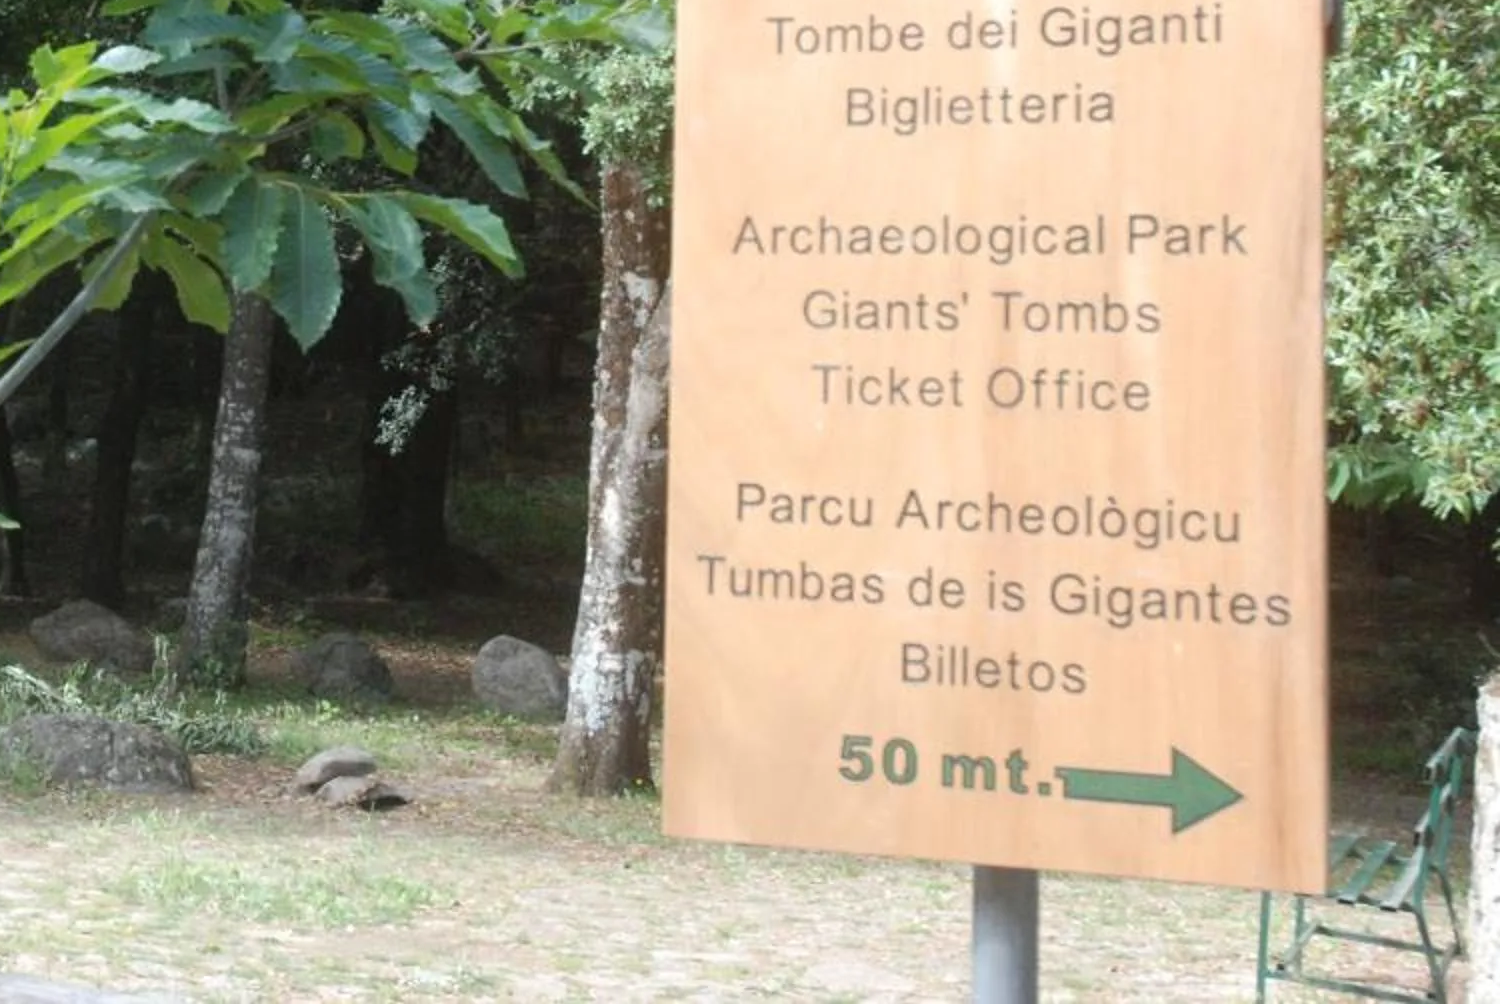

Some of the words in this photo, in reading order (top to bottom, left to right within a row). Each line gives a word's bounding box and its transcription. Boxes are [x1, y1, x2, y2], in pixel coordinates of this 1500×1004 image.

[767, 13, 925, 55] Tombe
[947, 9, 1018, 49] dei
[1040, 2, 1223, 56] Giganti
[846, 83, 1116, 135] Biglietteria
[732, 215, 1106, 264] Archaeological
[1127, 213, 1248, 257] Park
[802, 289, 969, 332] Giants'
[993, 291, 1162, 334] Tombs
[811, 364, 964, 408] Ticket
[987, 368, 1152, 412] Office
[736, 483, 873, 526] Parcu
[896, 489, 1241, 550] Archeològicu
[697, 554, 885, 604] Tumbas
[908, 567, 965, 609] de
[987, 570, 1026, 612] is
[1050, 573, 1292, 628] Gigantes
[901, 643, 1088, 695] Billetos
[838, 734, 919, 786] 50
[941, 748, 1054, 796] mt.
